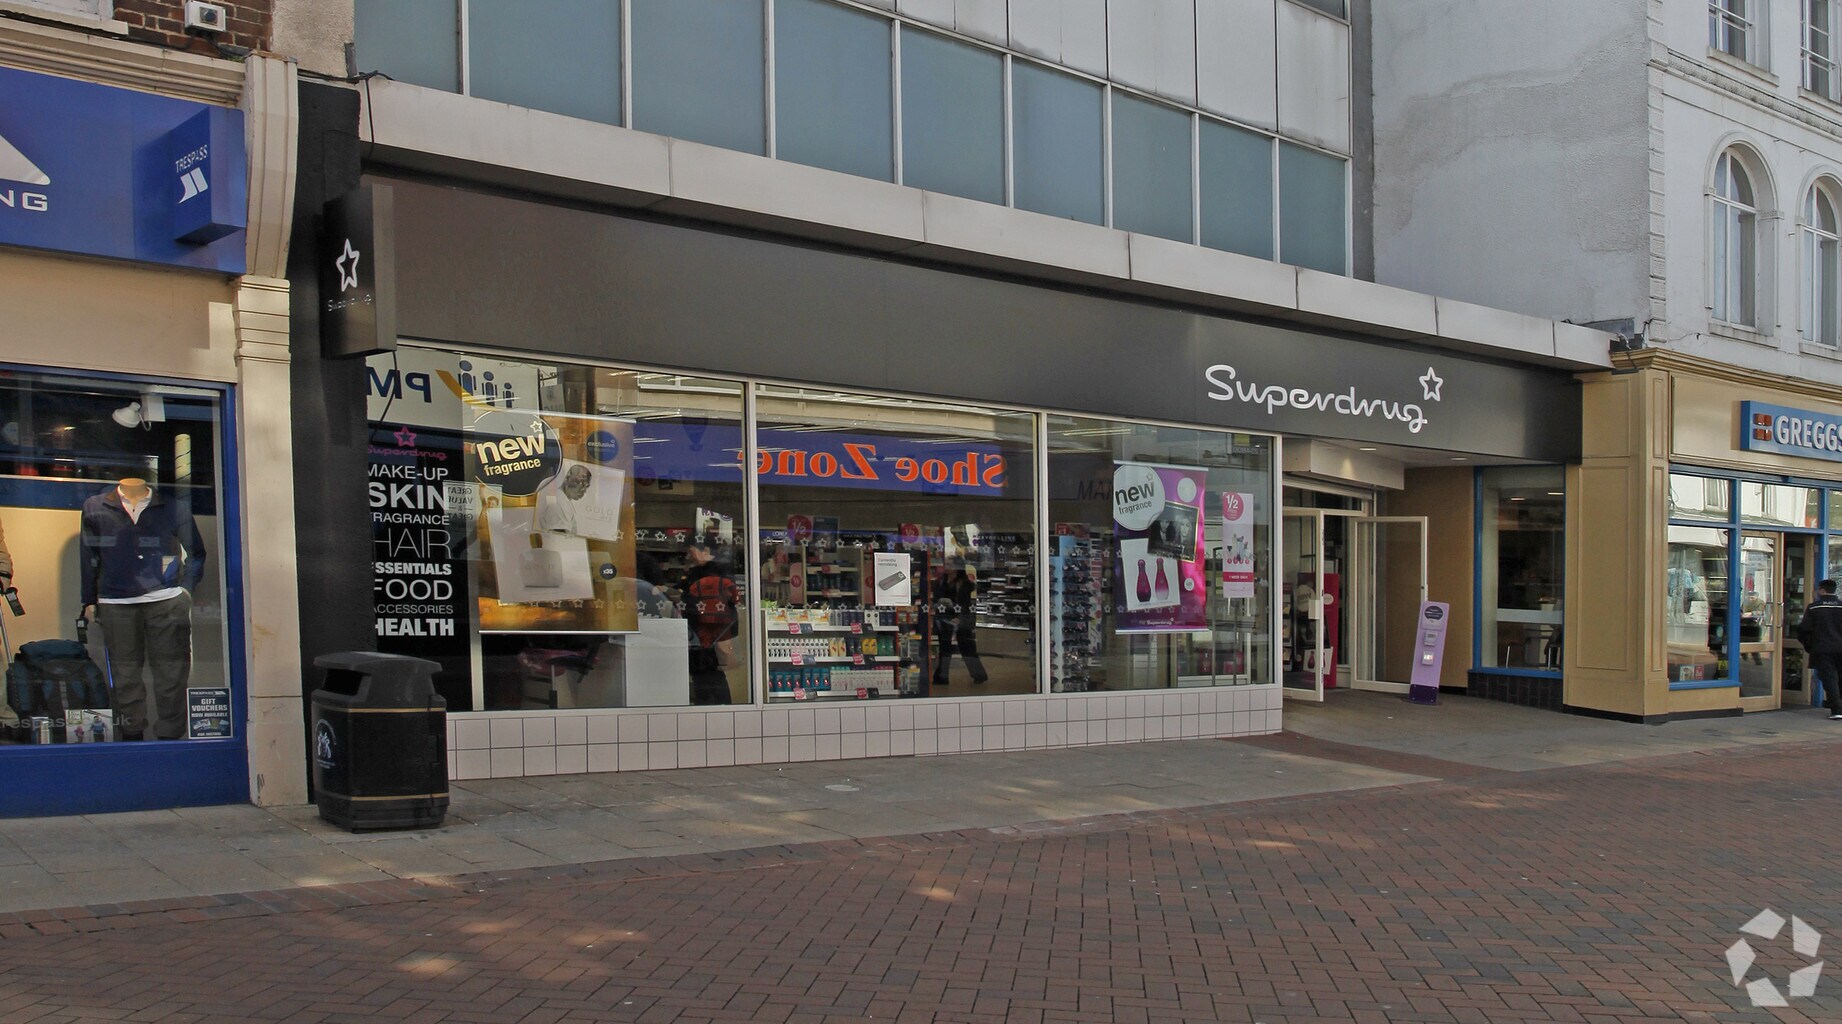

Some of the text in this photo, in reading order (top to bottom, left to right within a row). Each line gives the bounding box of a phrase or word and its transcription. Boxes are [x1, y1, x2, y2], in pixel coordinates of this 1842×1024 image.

[1205, 364, 1428, 433] Superdrug
[476, 433, 545, 465] new
[368, 463, 449, 481] MAKE-UP
[484, 458, 542, 477] fragrance
[369, 482, 450, 510] SKIN
[1115, 482, 1155, 506] new
[1119, 501, 1153, 515] fragrance
[371, 512, 450, 526] RAGRANCE
[372, 562, 452, 575] SSENTIALS
[374, 604, 454, 614] CCESSORIES
[375, 618, 455, 636] HEALTH
